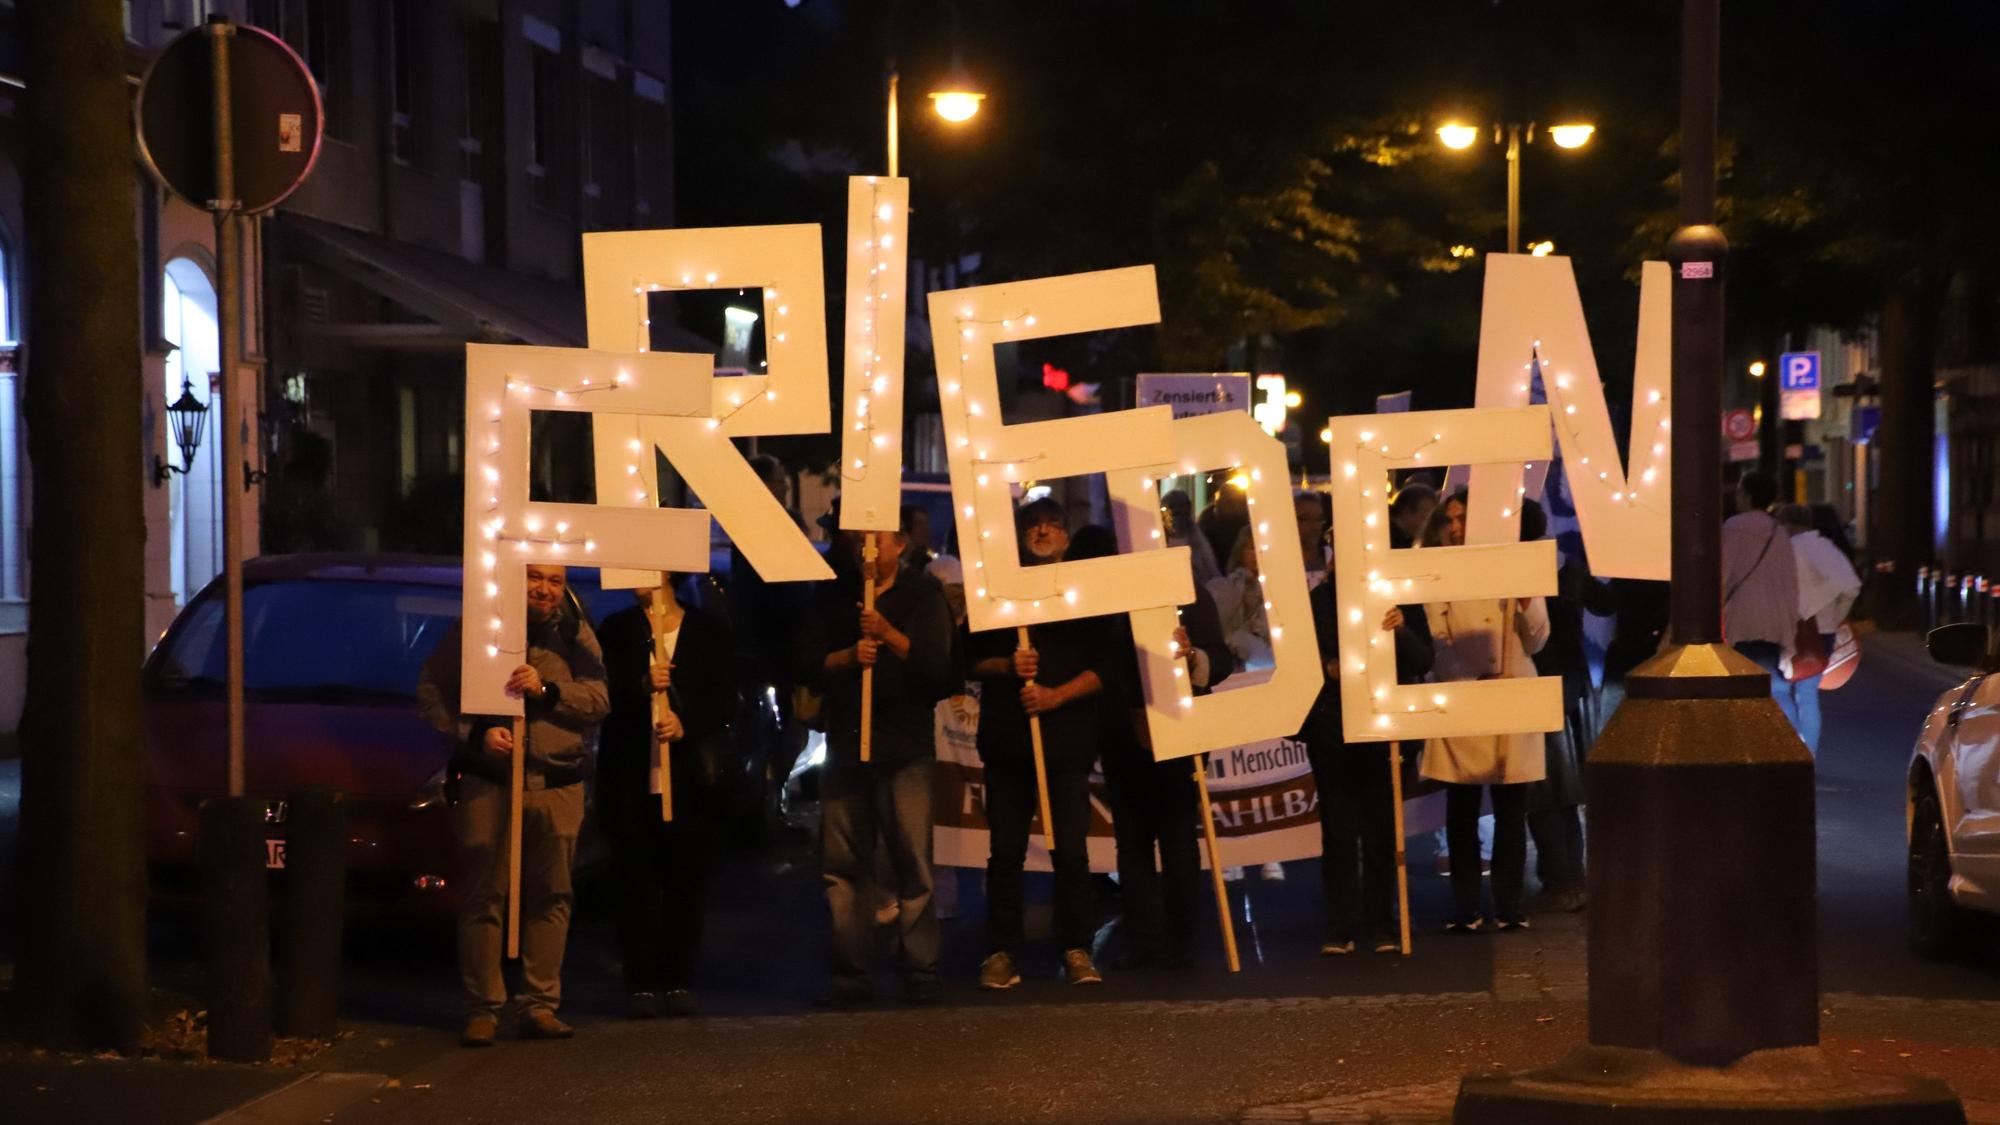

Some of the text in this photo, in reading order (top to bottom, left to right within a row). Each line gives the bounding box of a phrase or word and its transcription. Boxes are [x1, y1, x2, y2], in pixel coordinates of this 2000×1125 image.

[1789, 357, 1812, 387] P
[1152, 389, 1234, 403] Zensierts
[460, 176, 1672, 762] FRIEDEN
